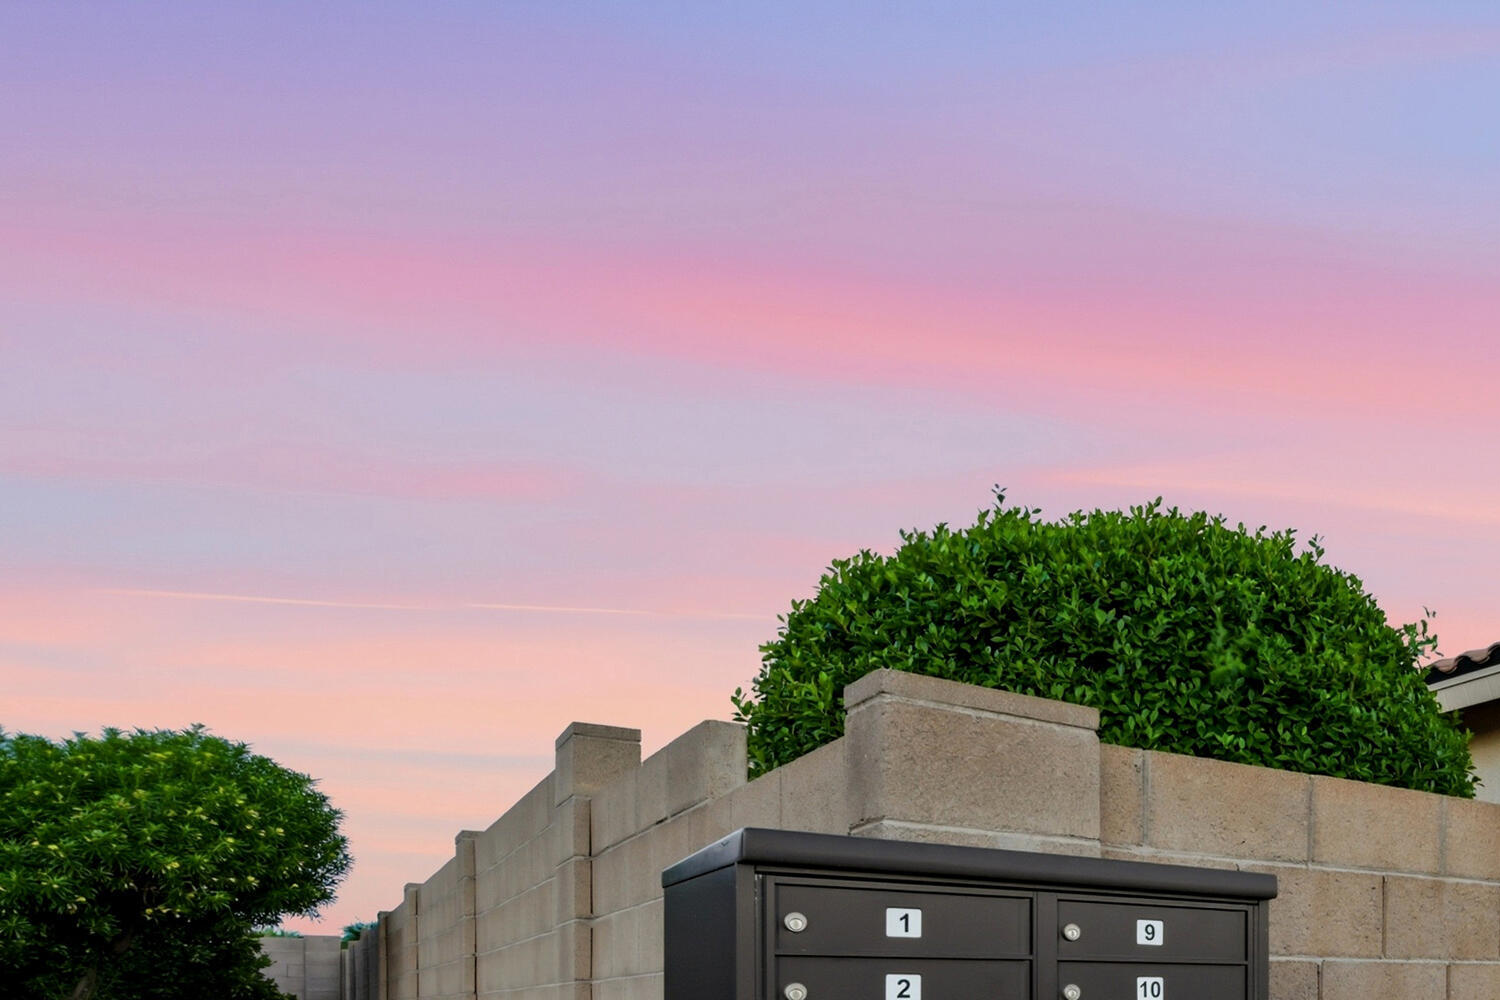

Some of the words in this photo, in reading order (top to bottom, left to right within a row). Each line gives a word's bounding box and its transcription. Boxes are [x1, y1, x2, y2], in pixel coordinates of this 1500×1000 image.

[899, 913, 909, 933] 1
[1144, 923, 1156, 941] 9
[896, 978, 911, 999] 2
[1139, 980, 1161, 998] 10
